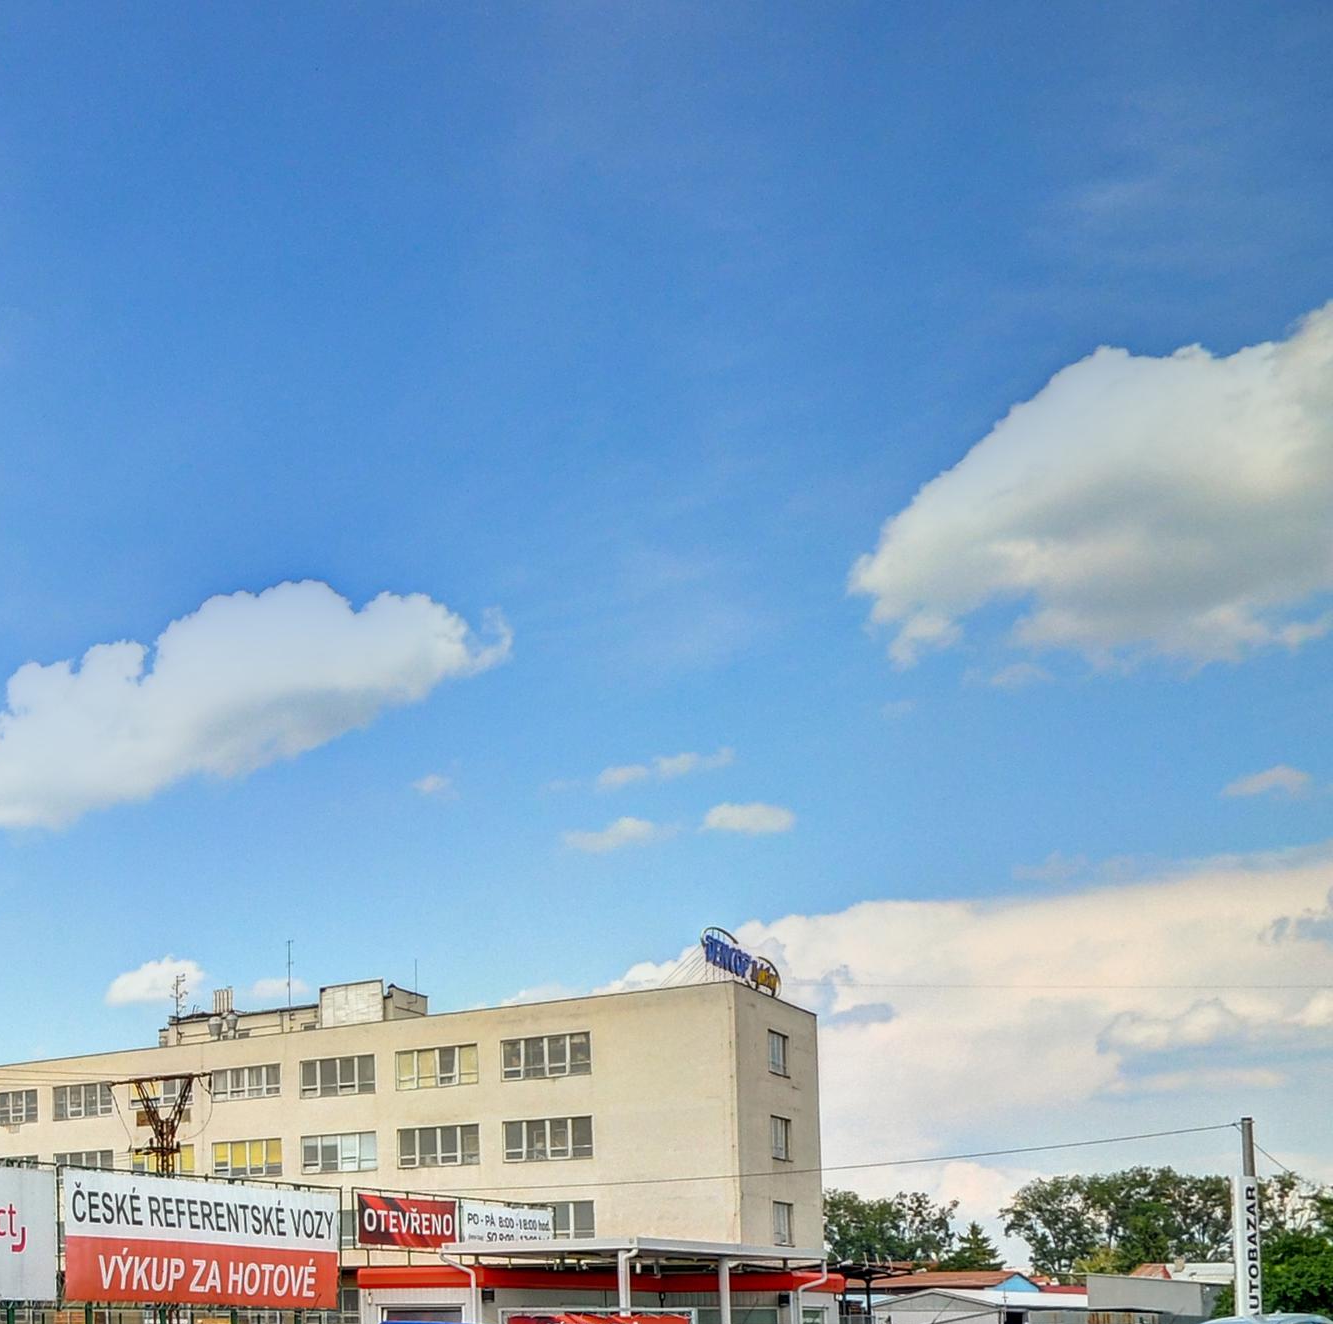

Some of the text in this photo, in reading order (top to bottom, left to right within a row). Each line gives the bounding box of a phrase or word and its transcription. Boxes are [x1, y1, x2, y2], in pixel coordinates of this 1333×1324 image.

[72, 1182, 334, 1240] ČESKÉ REFERENTSKÉ VOZY
[363, 1206, 454, 1237] OTEVŘENO
[467, 1212, 480, 1225] PO
[98, 1247, 317, 1298] VÝKUP ZA HOTOVÉ
